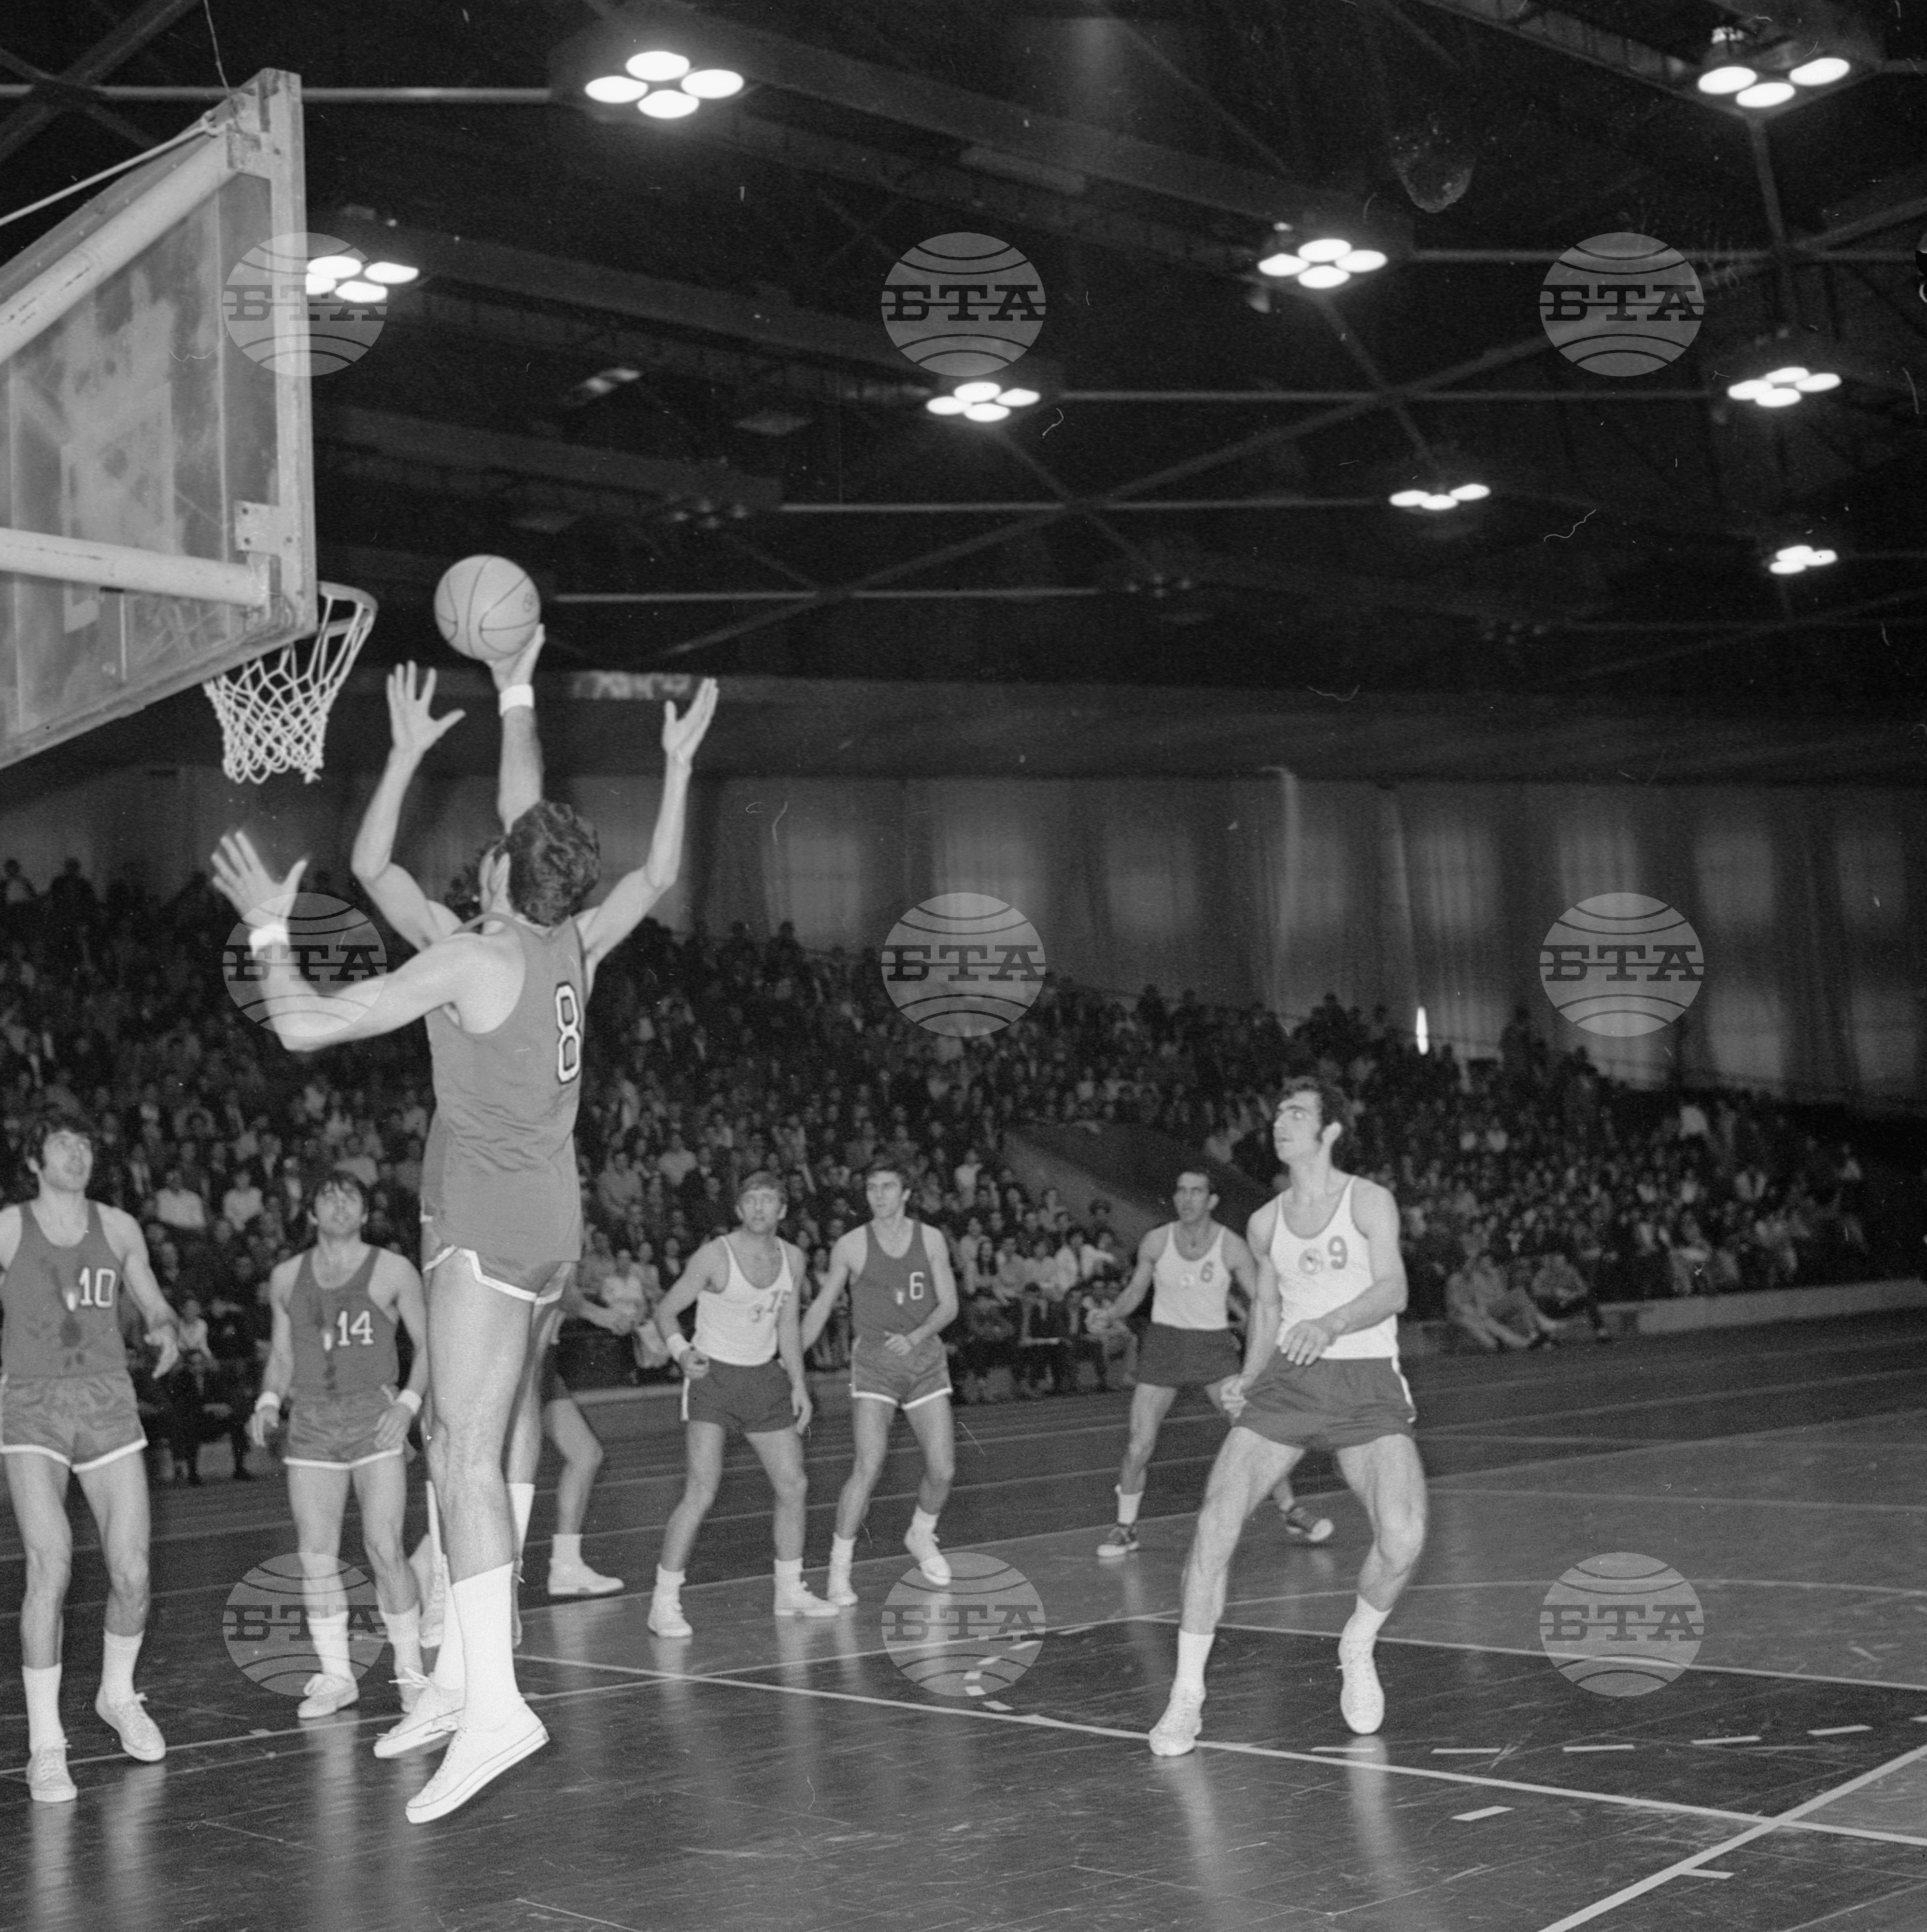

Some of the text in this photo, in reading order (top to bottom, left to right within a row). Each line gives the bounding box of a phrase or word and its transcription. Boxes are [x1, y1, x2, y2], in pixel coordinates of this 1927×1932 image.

[555, 981, 581, 1084] 8
[1327, 1235, 1348, 1270] 9
[79, 1266, 116, 1308] 10
[909, 1271, 925, 1300] 6
[1200, 1260, 1214, 1283] 6
[337, 1310, 374, 1347] 14
